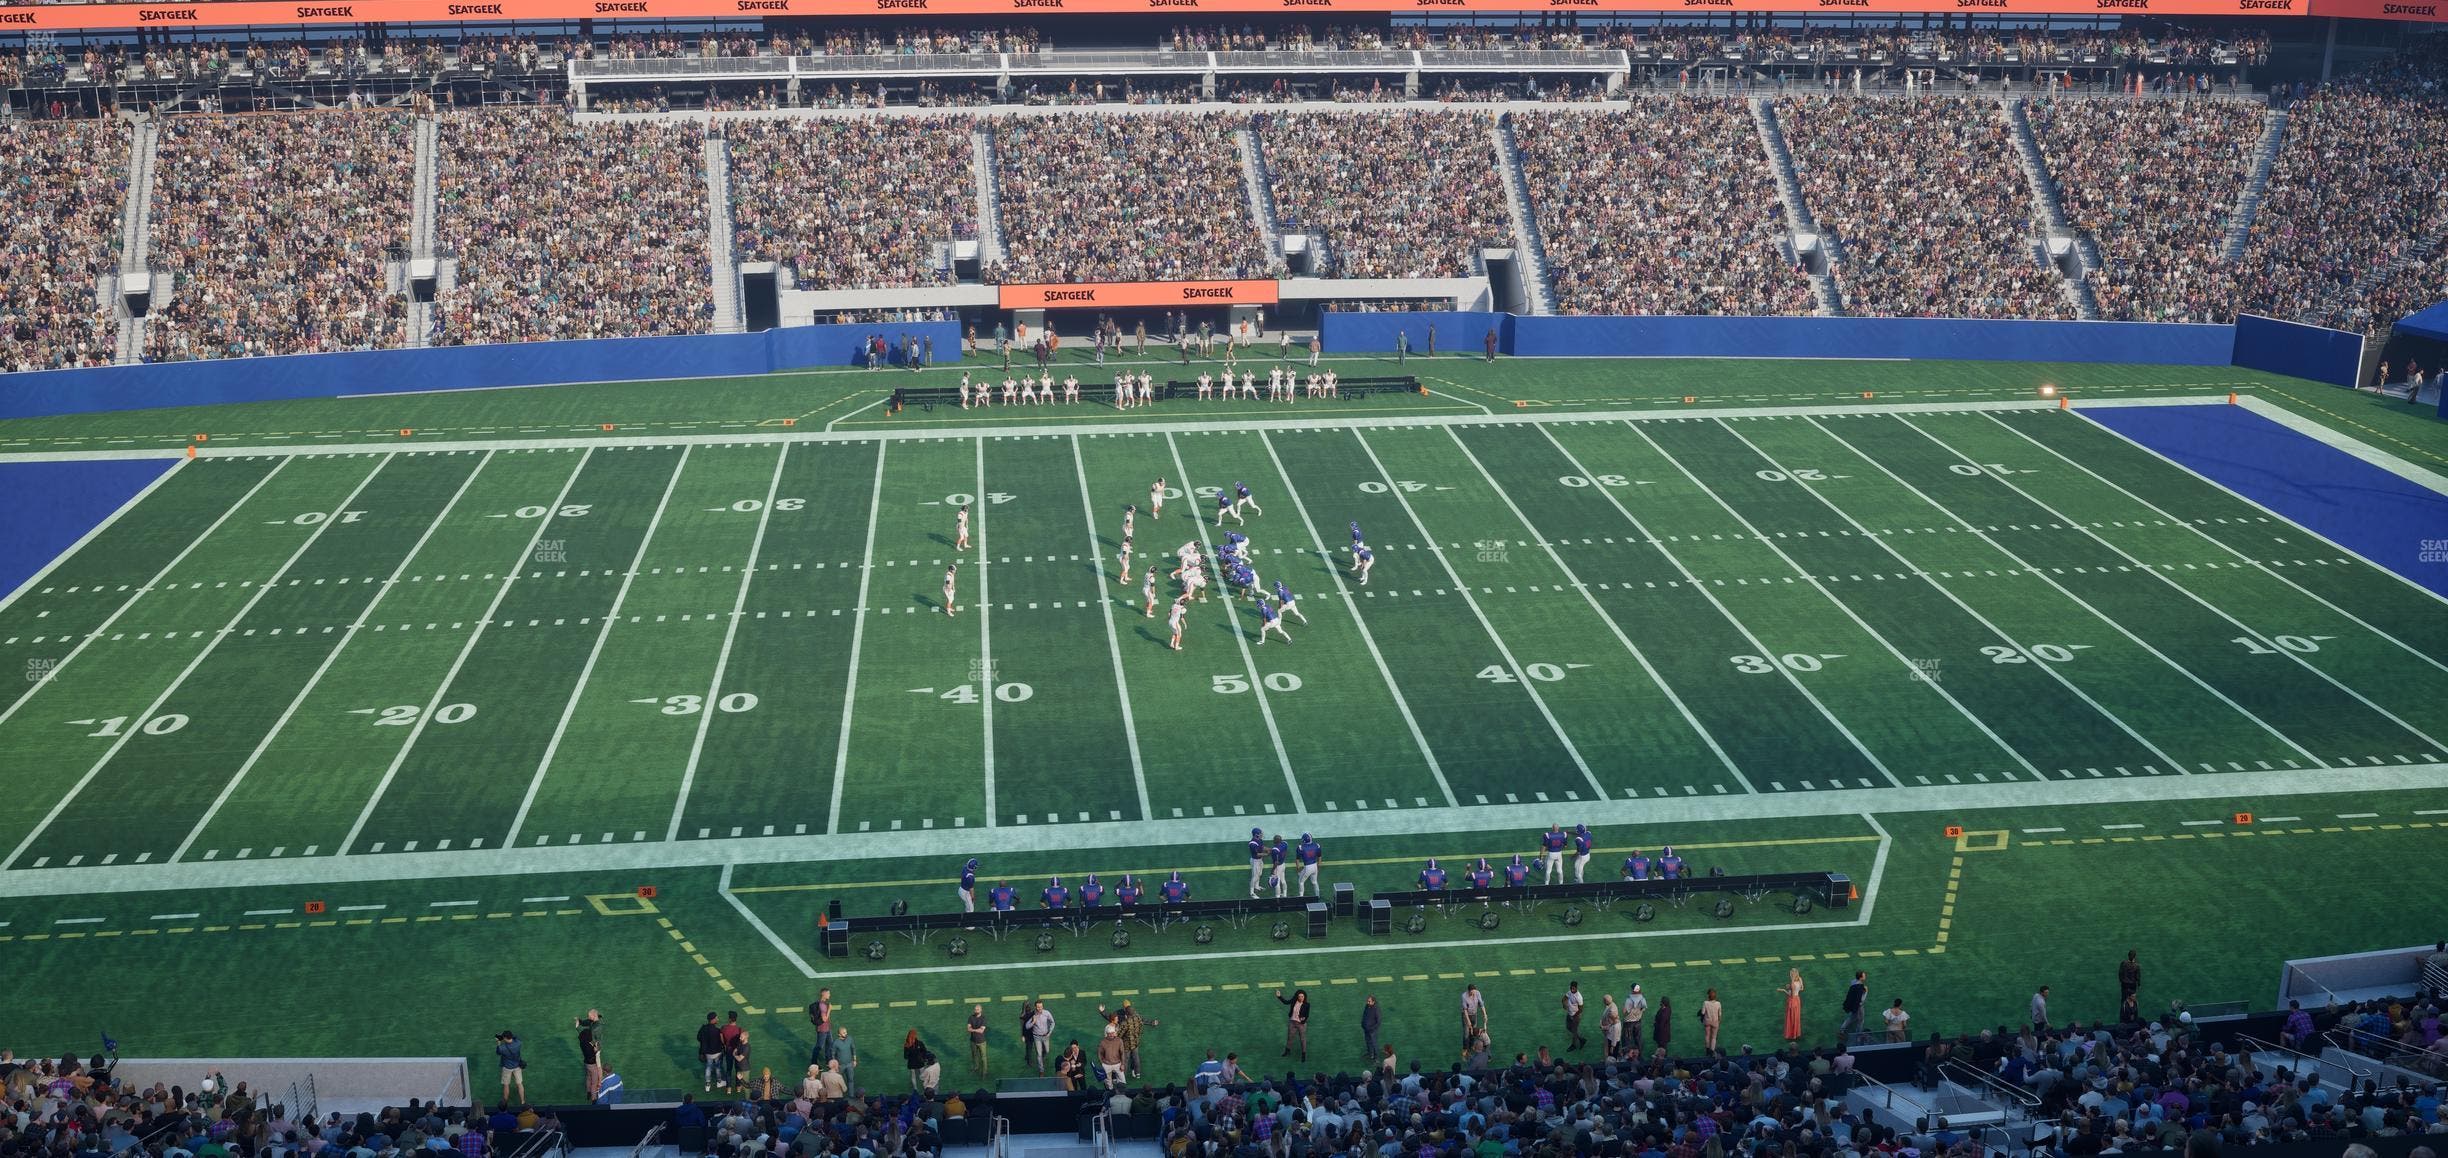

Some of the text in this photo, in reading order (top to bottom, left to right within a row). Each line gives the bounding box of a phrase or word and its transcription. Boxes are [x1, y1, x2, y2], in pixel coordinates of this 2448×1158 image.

[449, 4, 502, 14] SEATGEEK
[596, 2, 647, 12] SEATGEEK
[738, 0, 788, 10] SEATGEEK
[878, 0, 927, 9] SEATGEEK
[2097, 0, 2148, 8] SEATGEEK
[2240, 0, 2291, 9] SEATGEEK
[2383, 3, 2437, 16] SEATGEEK
[140, 10, 197, 21] SEATGEEK
[298, 7, 352, 17] SEATGEEK
[1044, 290, 1095, 301] SEATGEEK
[1184, 287, 1233, 298] SEATGEEK
[2230, 634, 2320, 655] 10
[1979, 644, 2075, 665] 20
[1730, 653, 1823, 675] 30
[1475, 662, 1566, 684] 40
[1211, 672, 1304, 695] 50
[940, 681, 1034, 704] 40
[660, 692, 760, 716] 30
[372, 702, 478, 726] 20
[87, 713, 190, 737] 10
